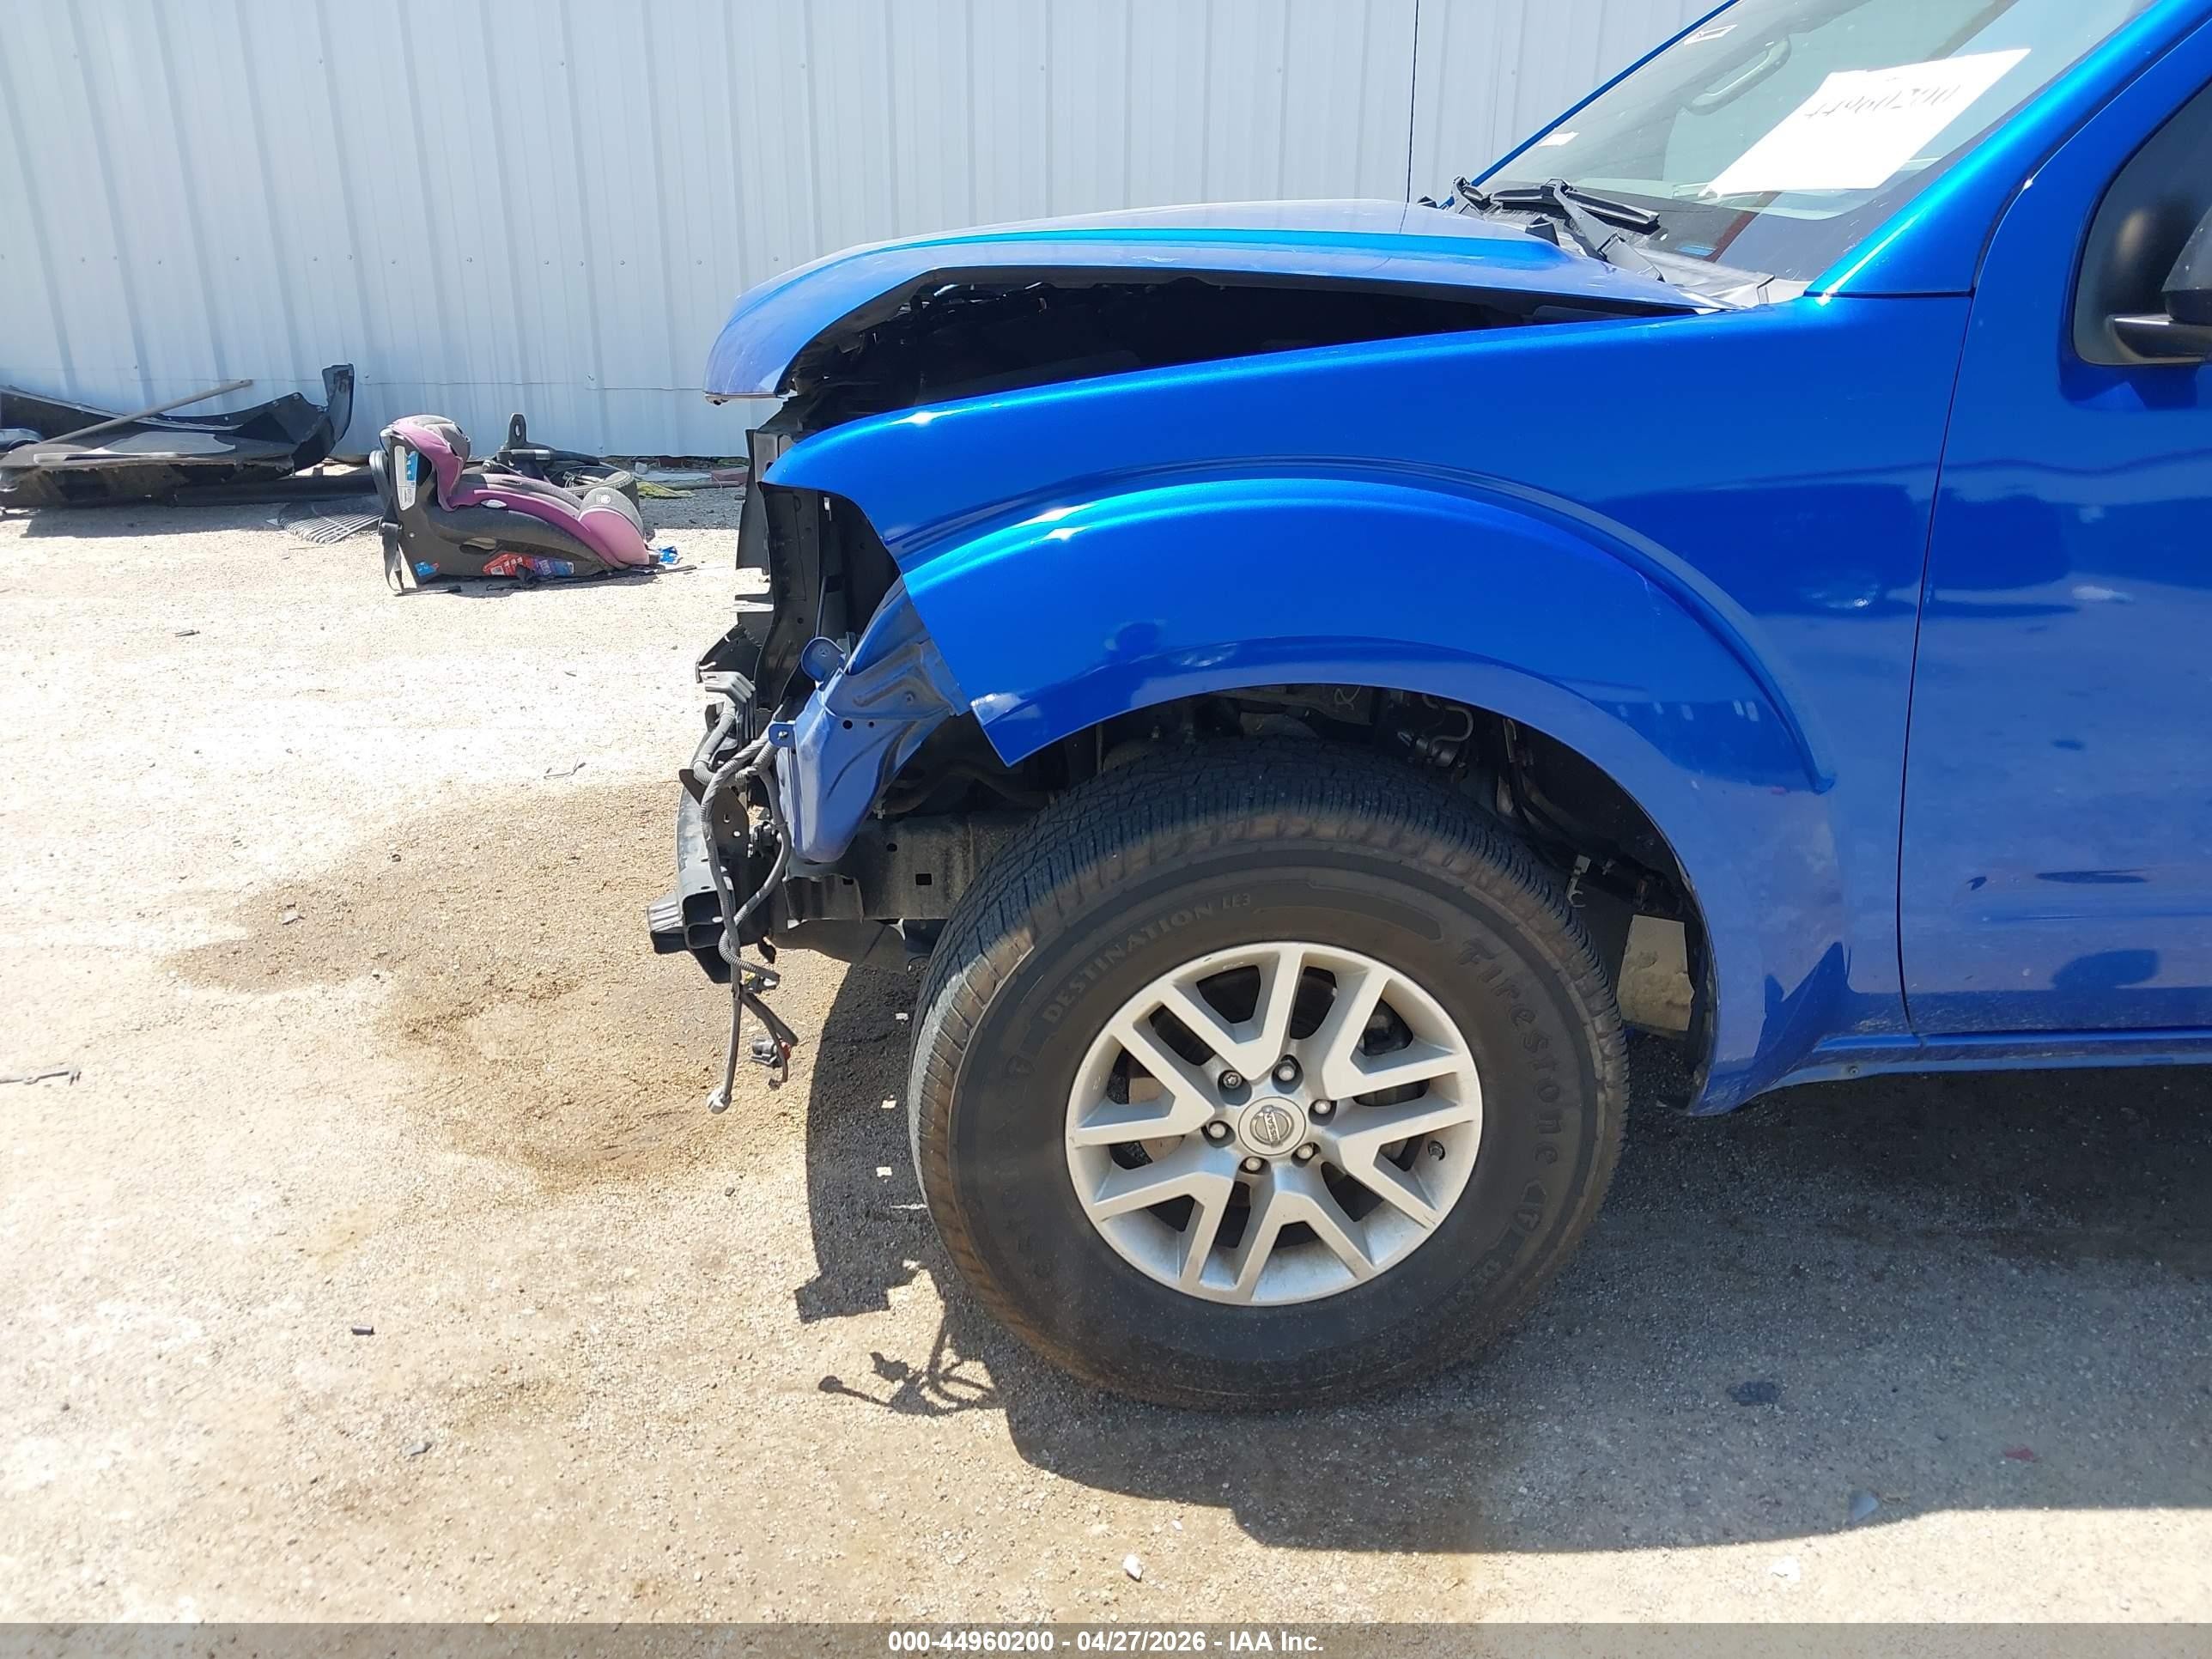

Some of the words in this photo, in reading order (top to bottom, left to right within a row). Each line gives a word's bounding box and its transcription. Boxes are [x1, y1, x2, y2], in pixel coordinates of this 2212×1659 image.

[1042, 902, 1218, 1024] DESTINATION
[1222, 893, 1251, 909] LE3
[1457, 939, 1562, 1165] Firestone
